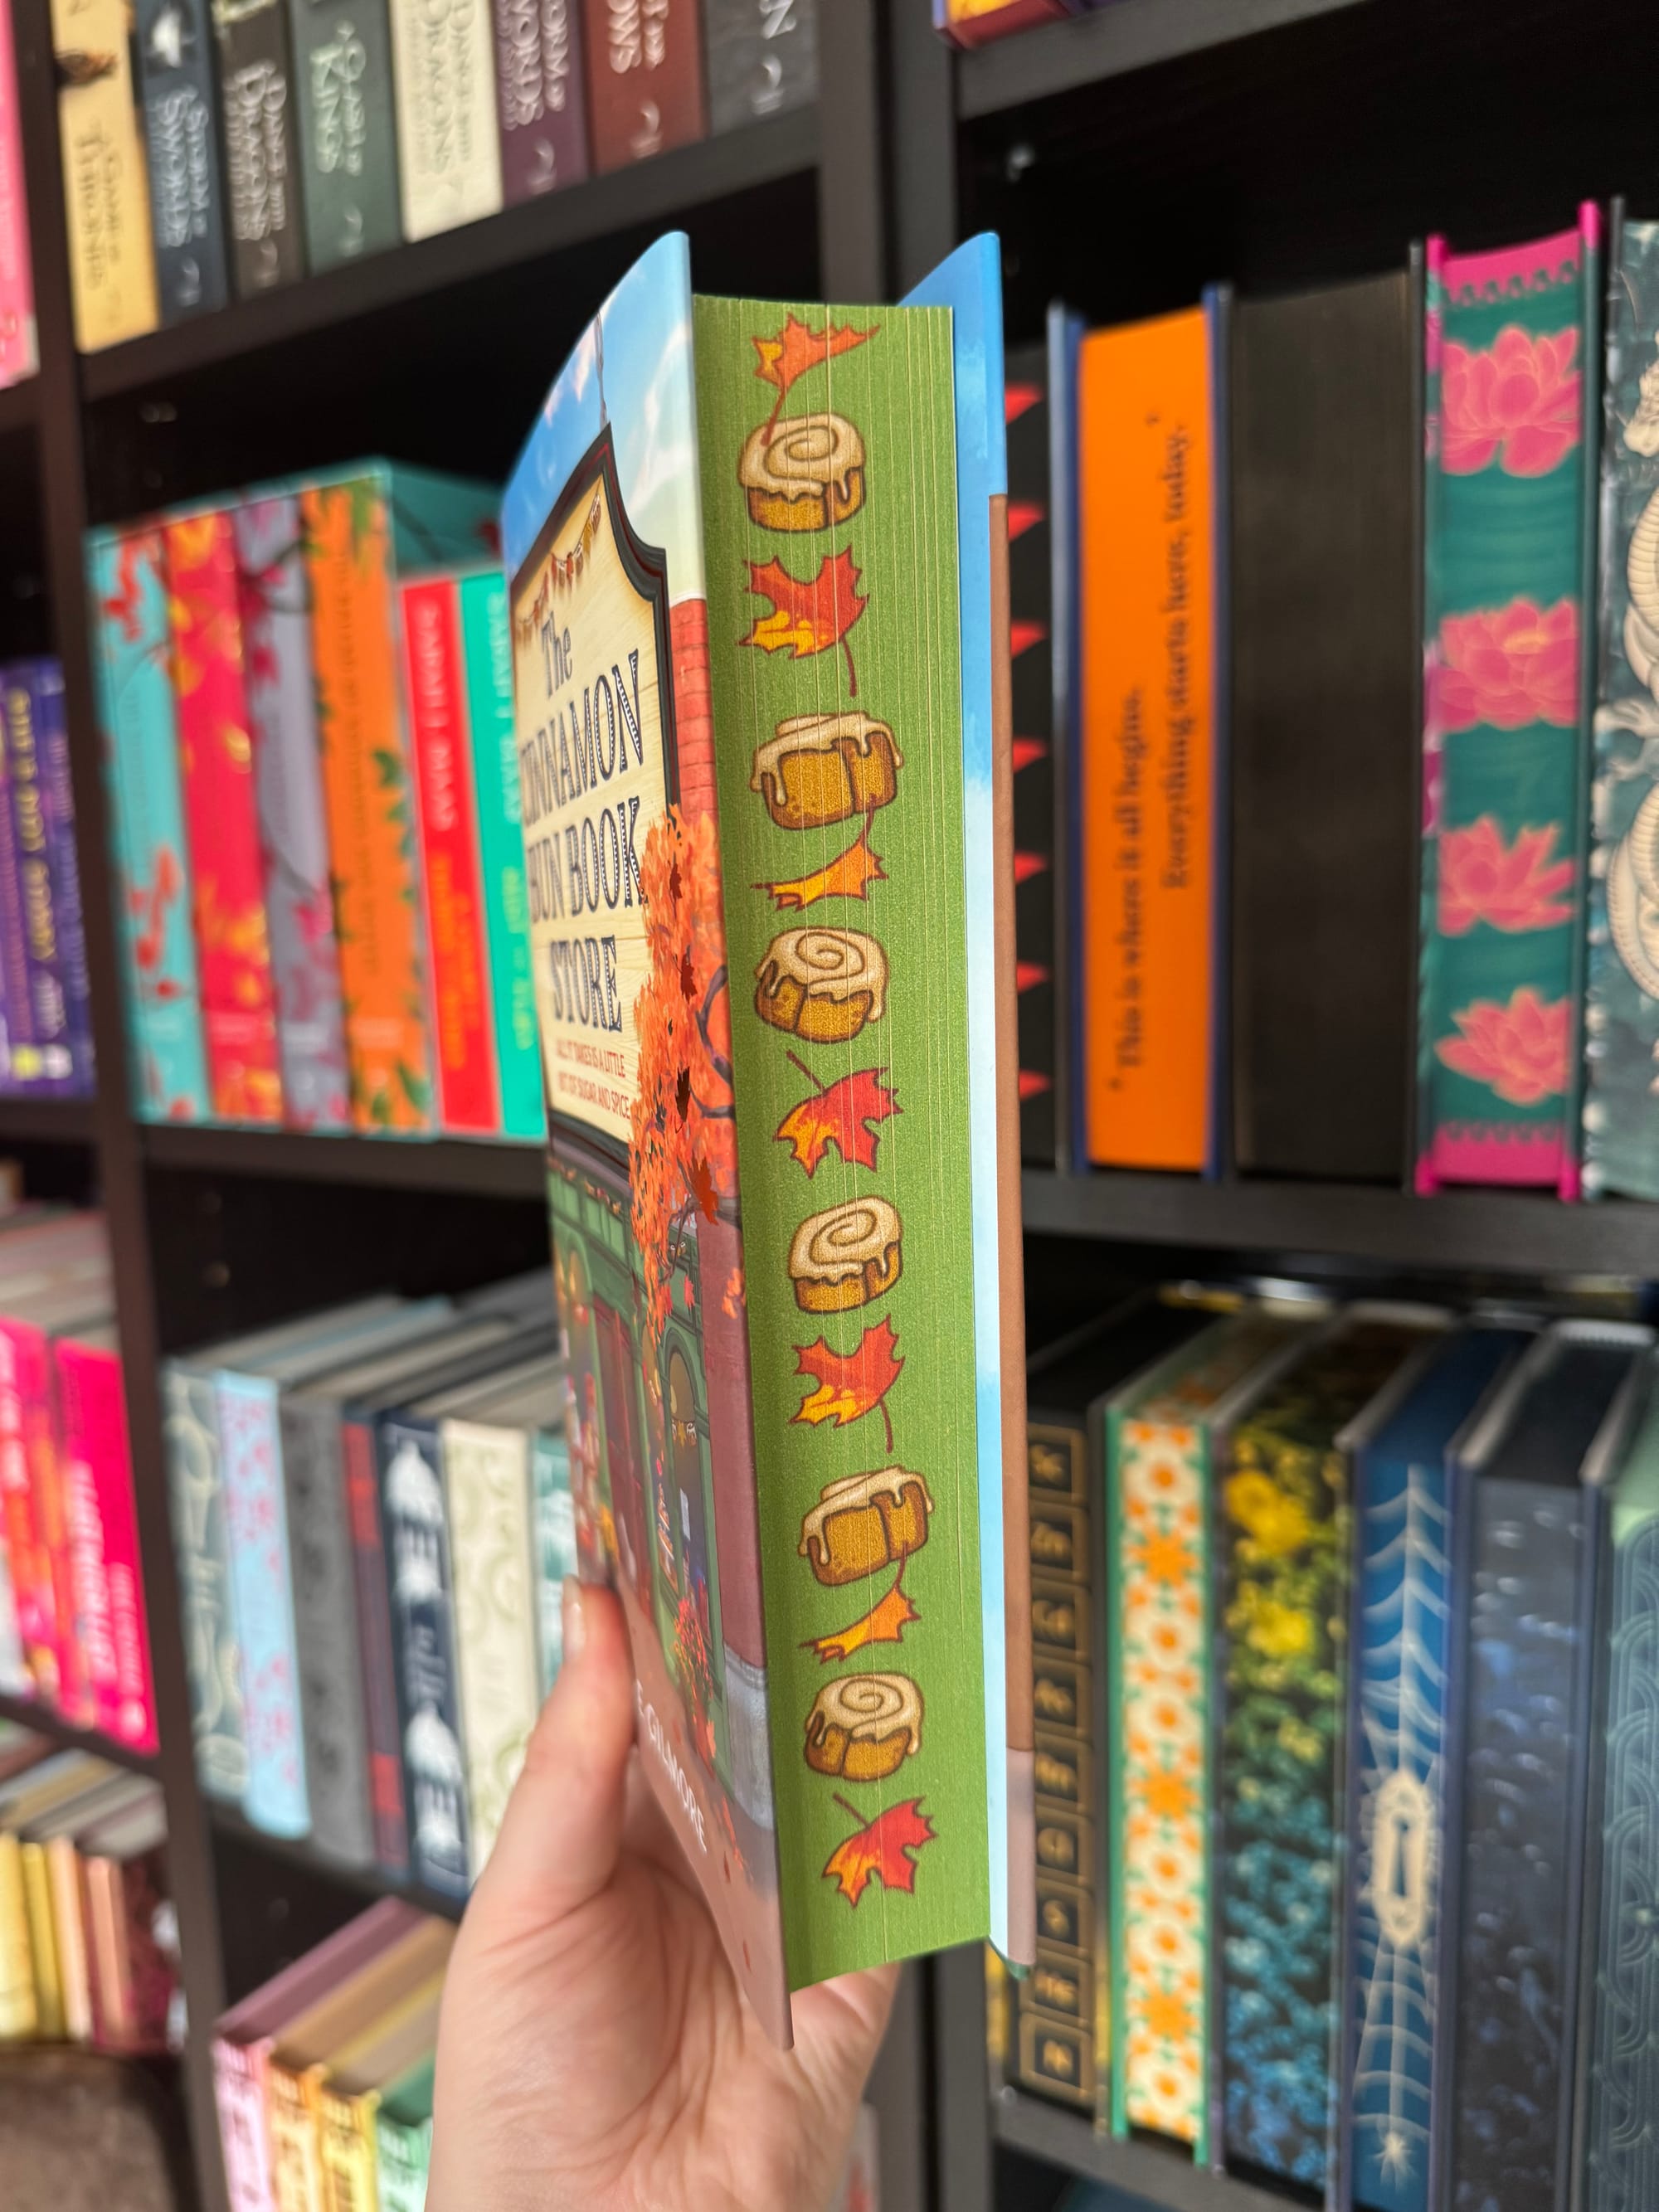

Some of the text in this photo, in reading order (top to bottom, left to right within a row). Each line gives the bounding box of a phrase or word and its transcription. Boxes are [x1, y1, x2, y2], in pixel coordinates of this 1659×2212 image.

[233, 66, 267, 241] DRAGONS
[309, 44, 343, 173] KINGS
[541, 610, 573, 698] The
[1164, 619, 1191, 712] starts
[1160, 715, 1196, 889] Everything
[566, 795, 649, 916] BOOK
[1114, 878, 1141, 967] where
[550, 935, 623, 1033] STORE
[598, 1084, 611, 1111] AND
[611, 1090, 631, 1121] SPICE
[605, 1049, 626, 1078] LITTLE
[644, 1703, 708, 1853] GILMORE
